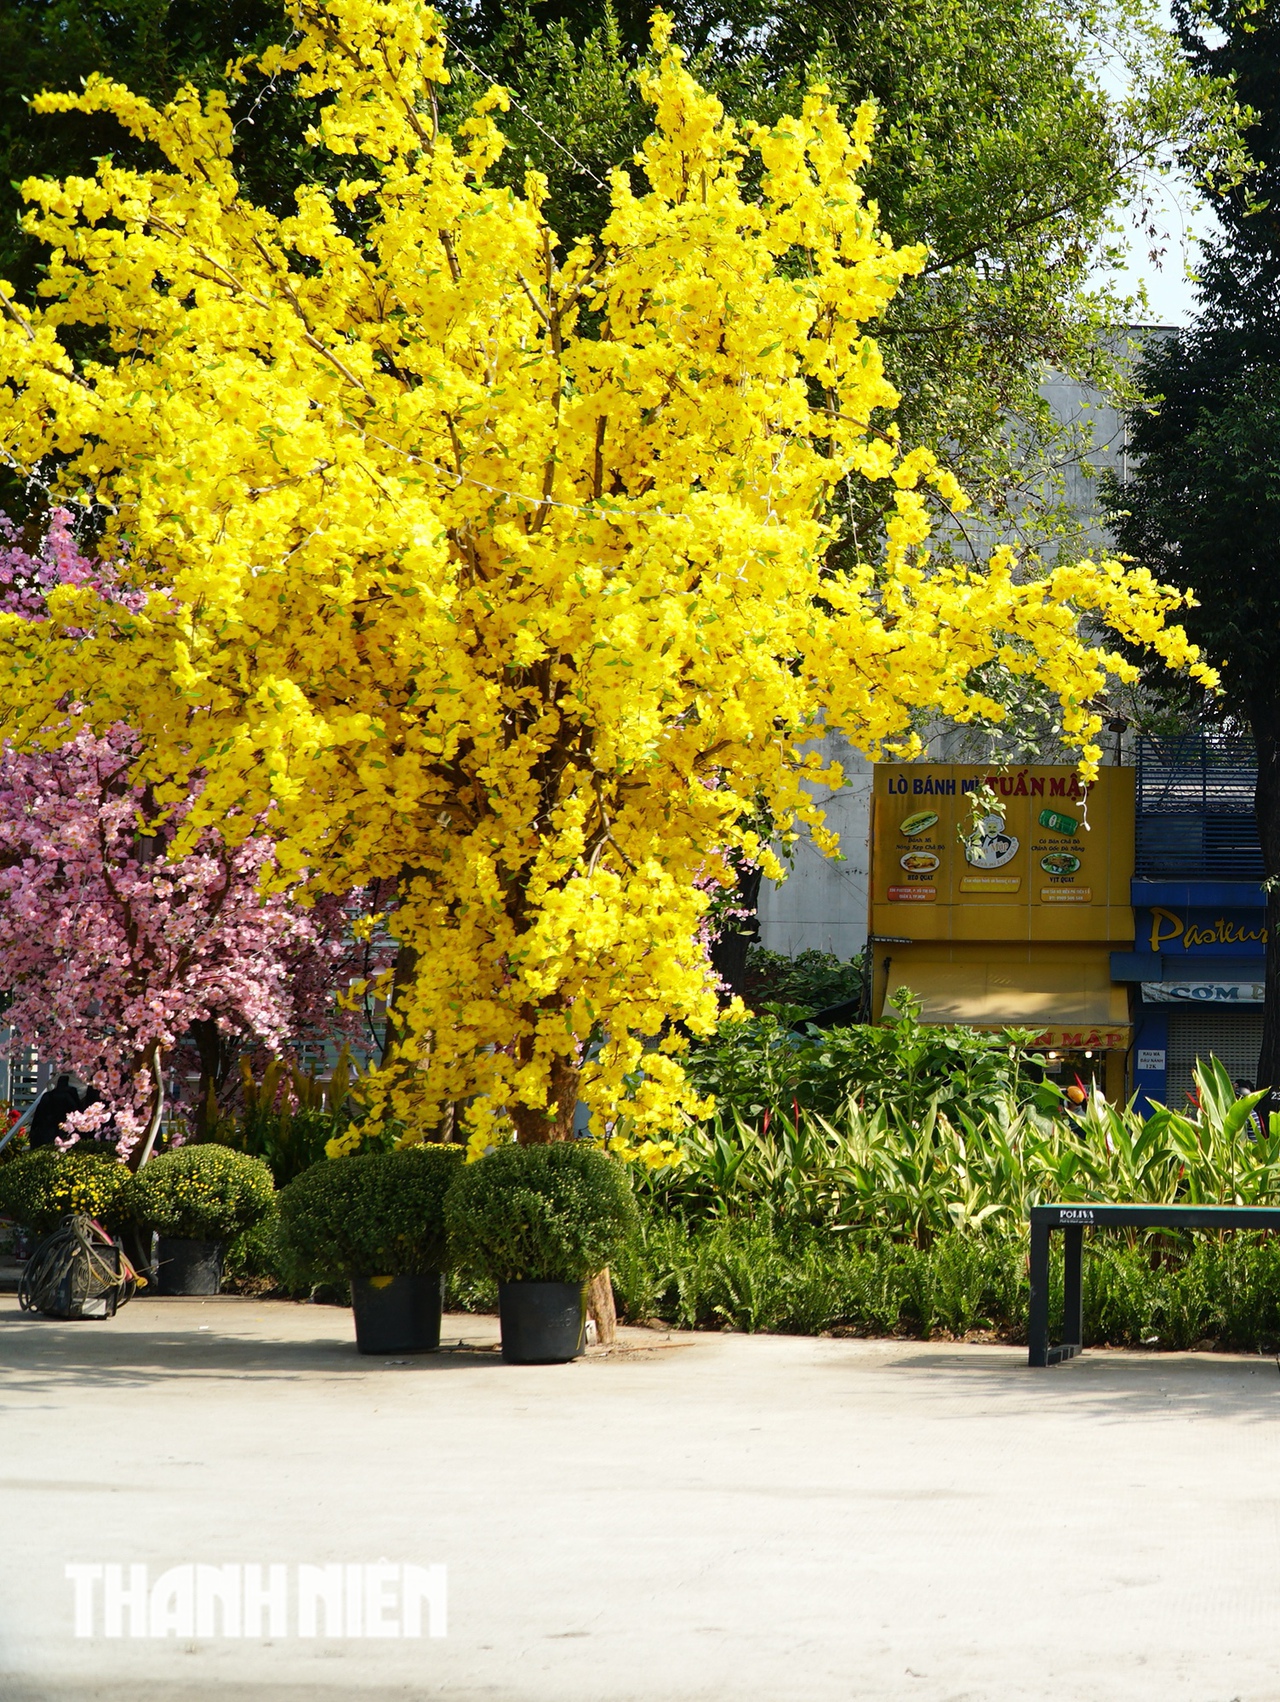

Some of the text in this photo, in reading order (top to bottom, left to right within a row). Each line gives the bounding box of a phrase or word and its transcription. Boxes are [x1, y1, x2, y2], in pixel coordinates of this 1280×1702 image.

[888, 774, 908, 795] LÒ
[913, 775, 956, 795] BÁNH
[985, 769, 1045, 797] TUẤN
[1148, 906, 1269, 952] Pasteur
[1170, 985, 1239, 999] CƠM
